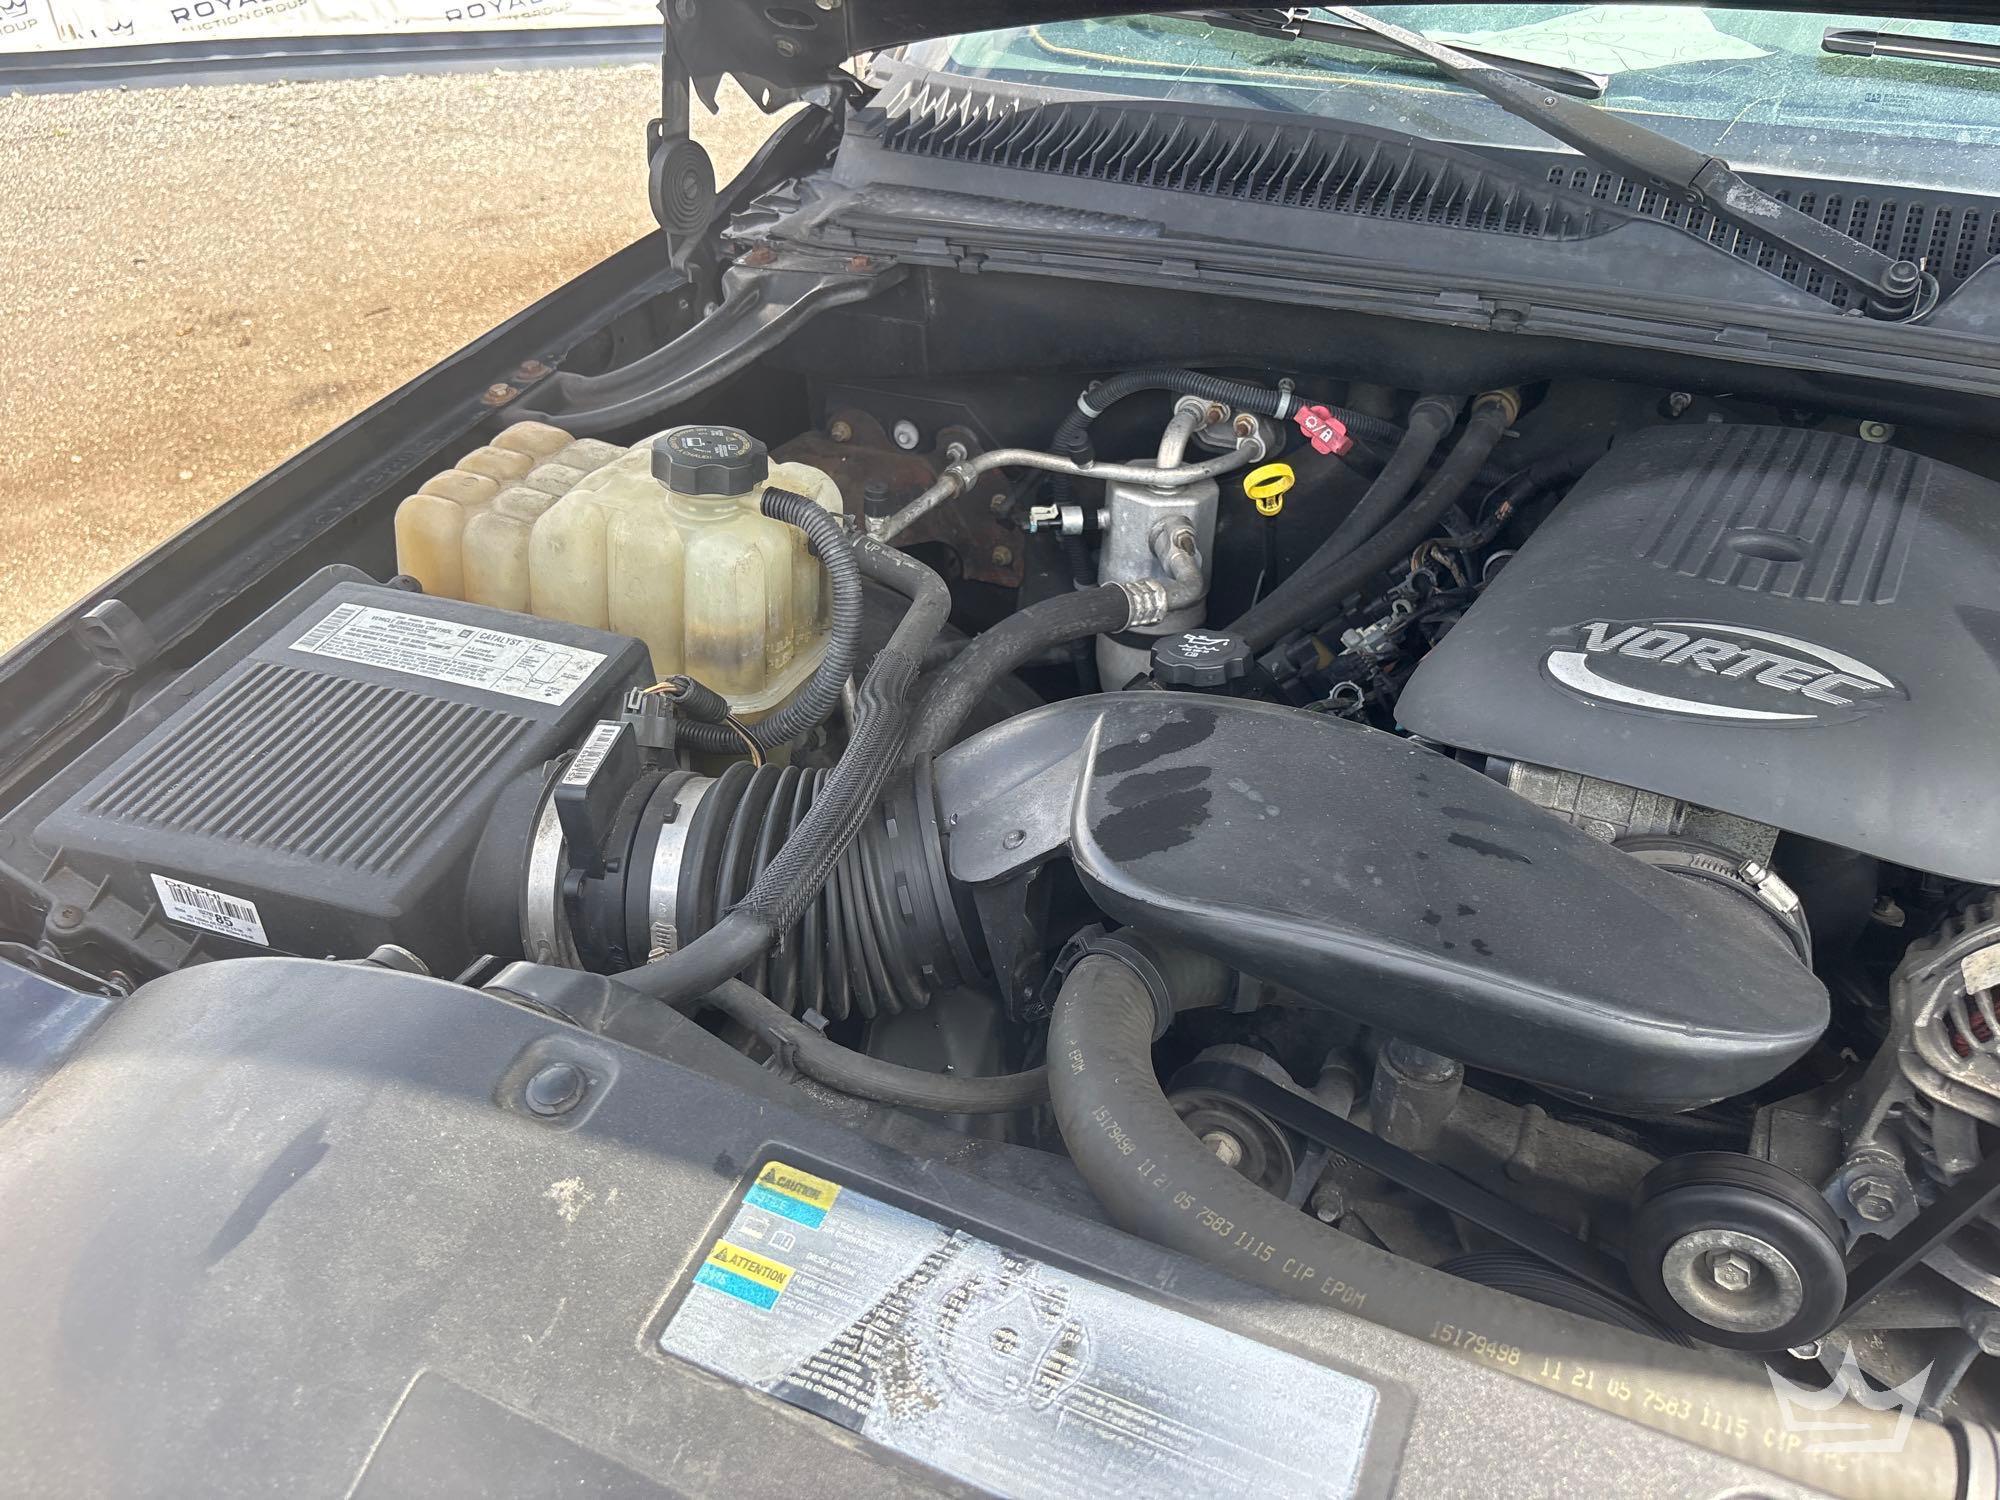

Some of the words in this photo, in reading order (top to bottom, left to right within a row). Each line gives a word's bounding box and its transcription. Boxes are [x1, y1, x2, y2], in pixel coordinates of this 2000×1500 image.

[479, 631, 522, 647] CATALYST
[1582, 622, 1880, 704] VORTEC
[215, 913, 234, 927] 85
[1067, 1049, 1086, 1075] EPDM
[776, 1176, 822, 1200] CAUTION
[1091, 1105, 1137, 1156] 15179498
[1137, 1158, 1155, 1177] 11
[1173, 1191, 1196, 1210] 05
[1195, 1206, 1235, 1237] 7583
[1234, 1231, 1276, 1262] 1115
[1282, 1258, 1315, 1281] CIP
[1320, 1277, 1367, 1310] EPDM
[730, 1253, 788, 1284] ATTENTION
[1429, 1320, 1521, 1366] 15179498
[1540, 1357, 1562, 1381] 11
[1571, 1367, 1595, 1390] 21
[1641, 1387, 1692, 1420] 7583
[1699, 1404, 1748, 1440] 1115
